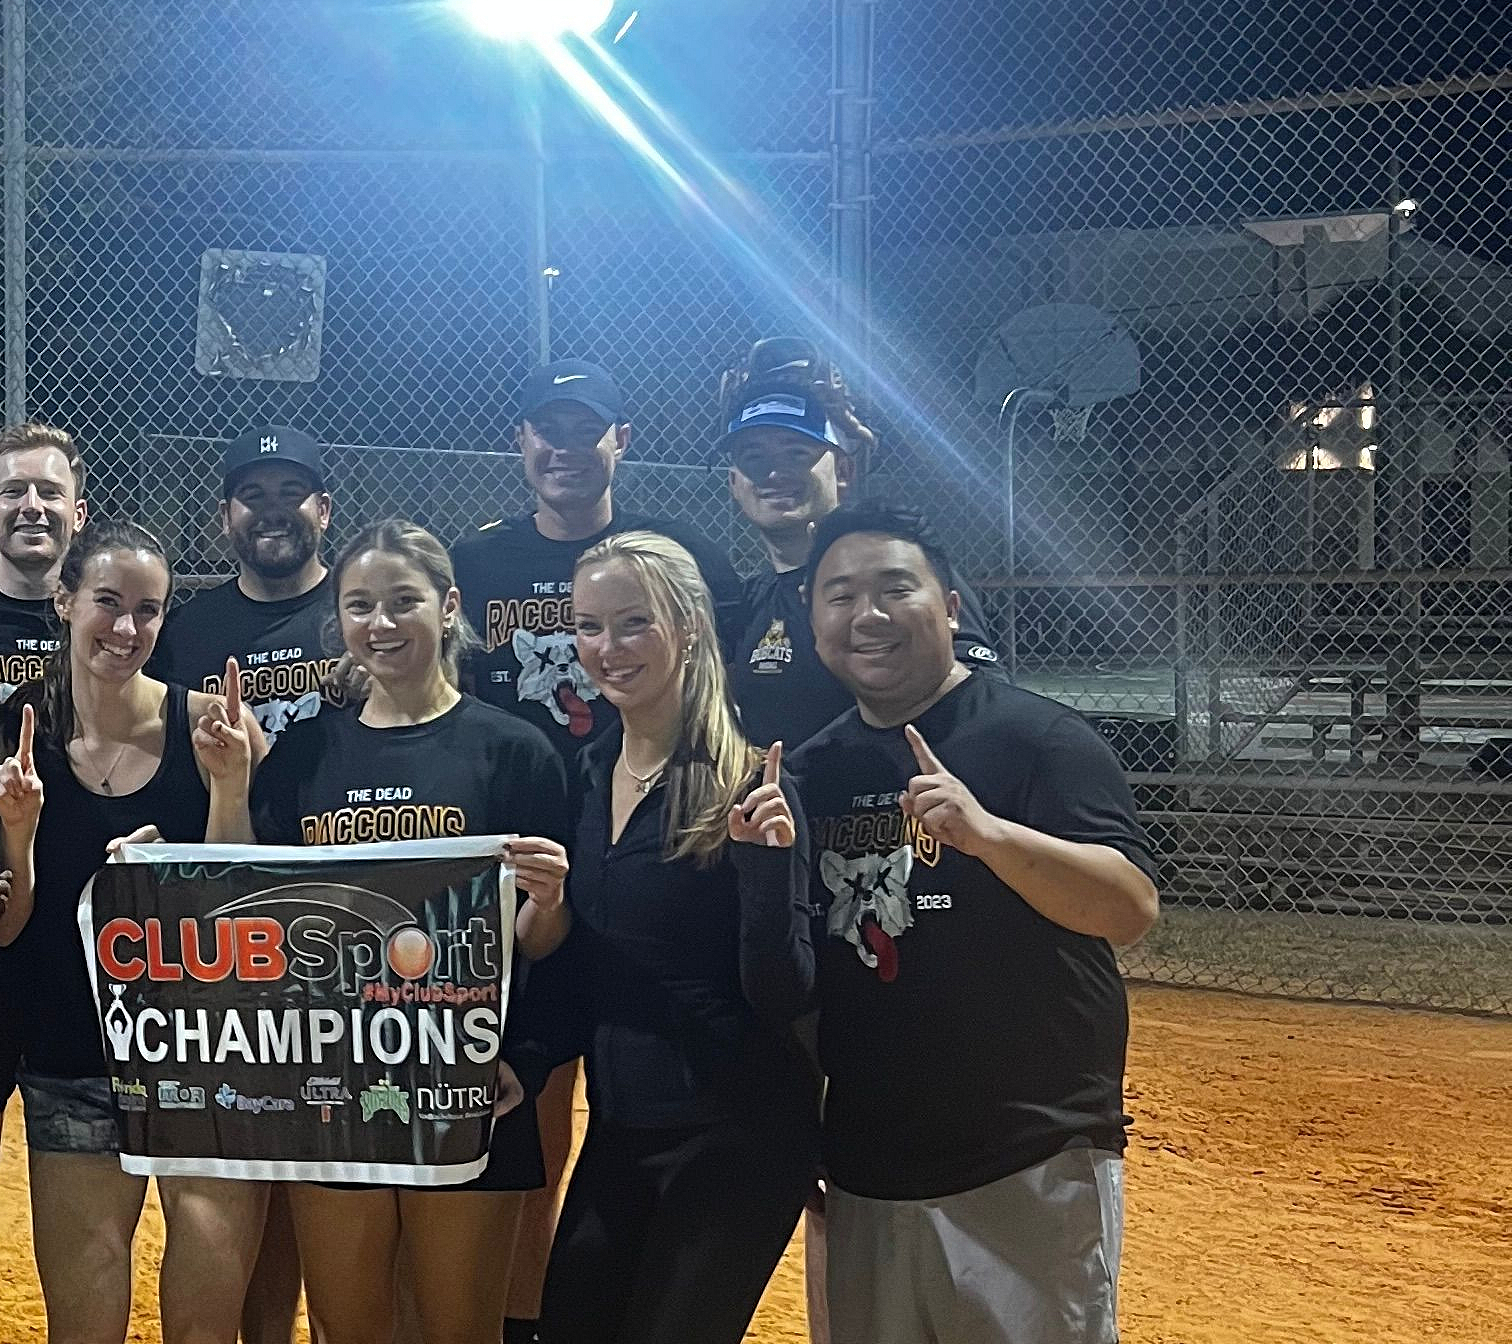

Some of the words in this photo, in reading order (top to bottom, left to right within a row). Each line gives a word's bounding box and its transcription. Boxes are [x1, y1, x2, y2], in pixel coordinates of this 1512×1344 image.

[532, 582, 555, 594] THE
[559, 582, 573, 593] DE
[486, 599, 576, 653] RACCO
[16, 640, 38, 650] THE
[40, 641, 61, 652] DEA
[247, 654, 269, 665] THE
[272, 648, 302, 662] DEAD
[347, 789, 371, 803] THE
[375, 787, 412, 801] DEAD
[852, 794, 877, 808] THE
[917, 895, 952, 910] 2023
[135, 1007, 500, 1065] CHAMPIONS
[300, 1084, 353, 1101] ULTRA
